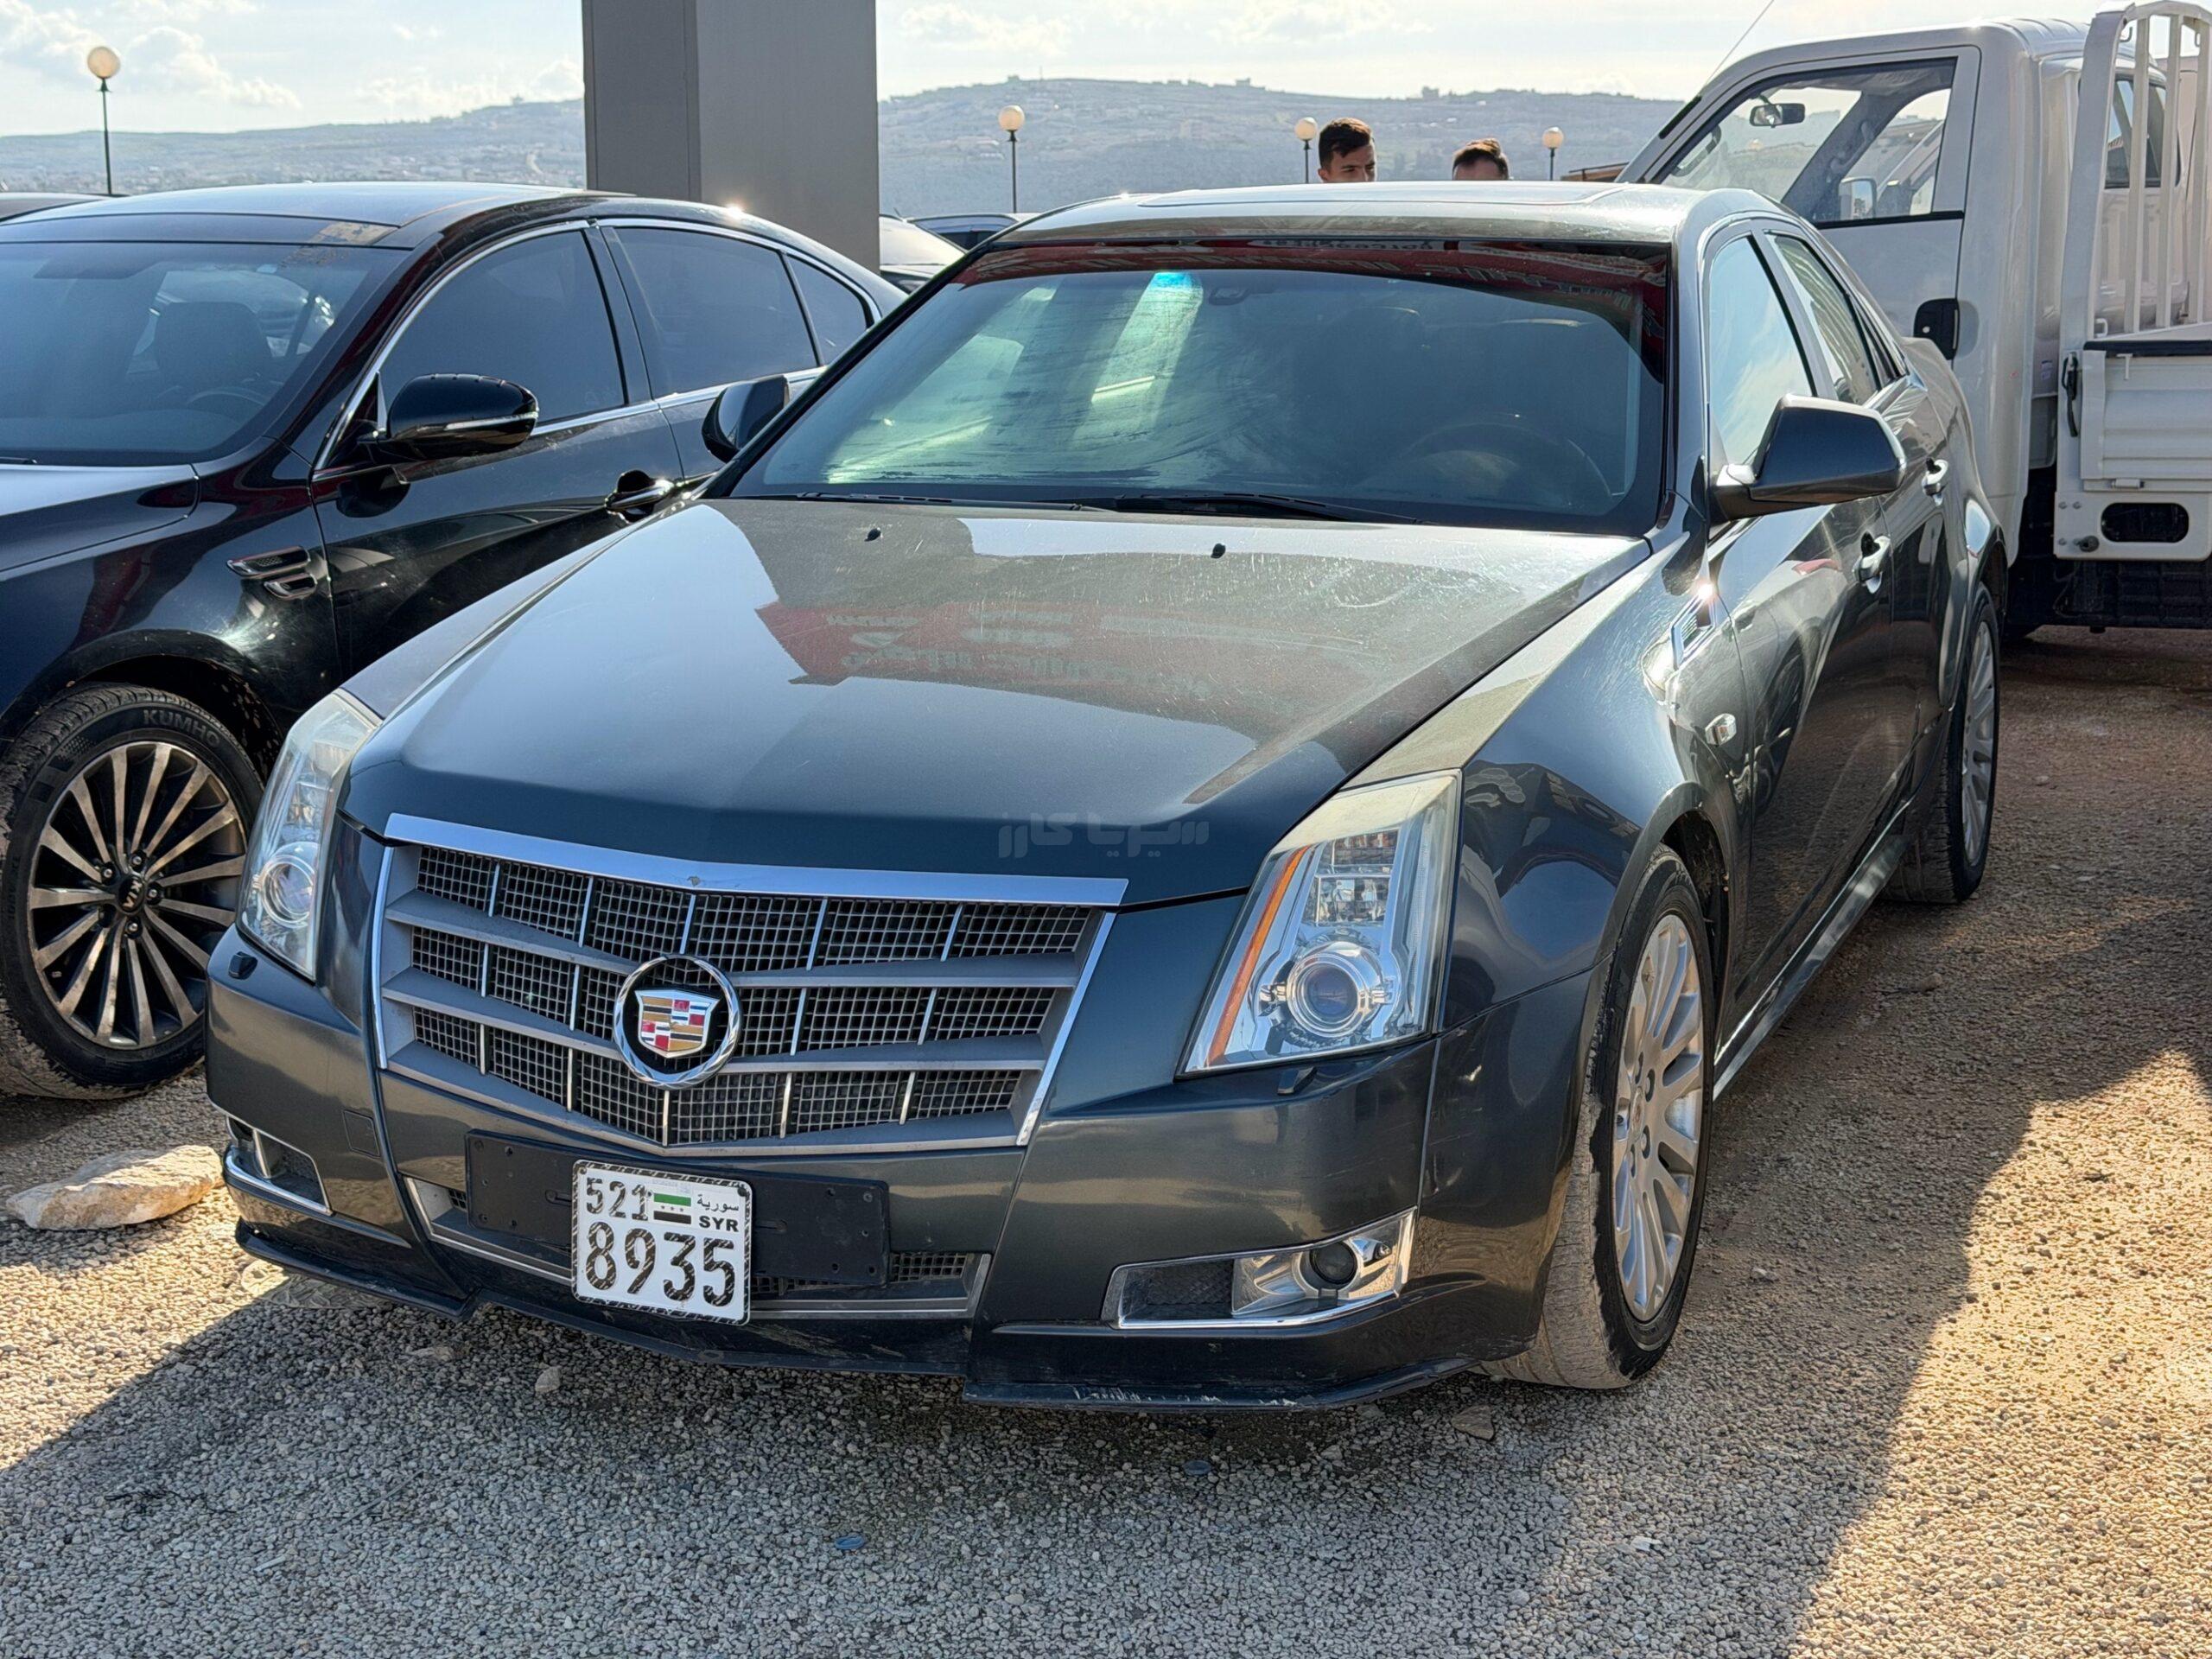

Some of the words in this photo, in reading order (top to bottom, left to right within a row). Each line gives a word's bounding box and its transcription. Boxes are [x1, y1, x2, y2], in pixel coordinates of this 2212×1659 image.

[143, 709, 220, 747] KUMHO
[123, 880, 143, 909] KIA
[586, 1177, 649, 1222] 521
[696, 1193, 740, 1214] سورية
[699, 1215, 740, 1233] SYR
[585, 1221, 736, 1307] 8935
